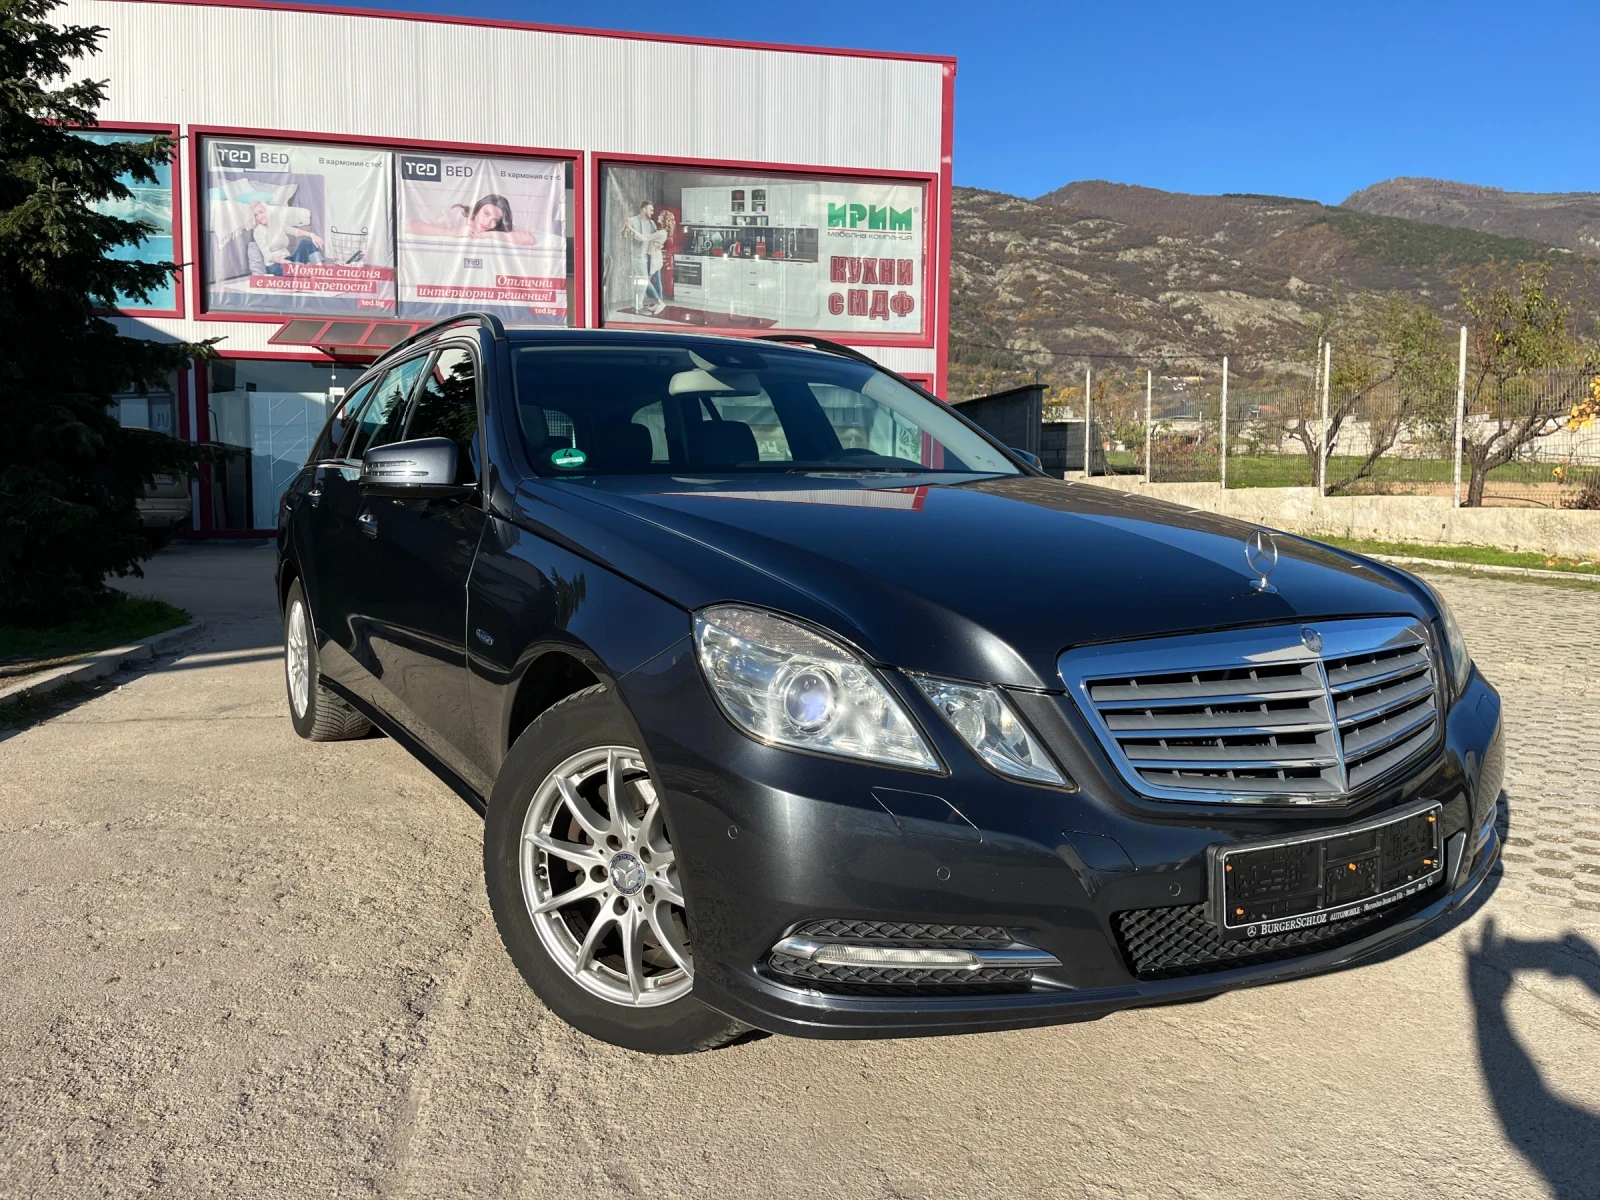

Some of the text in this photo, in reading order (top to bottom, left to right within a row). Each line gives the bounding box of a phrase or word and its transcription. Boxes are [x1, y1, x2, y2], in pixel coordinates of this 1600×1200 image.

[260, 153, 289, 166] BED
[326, 159, 364, 167] хармония
[445, 165, 473, 178] BED
[507, 172, 543, 180] хармония
[828, 203, 912, 231] ИРИМ
[287, 264, 381, 279] Моята спалня
[831, 256, 913, 285] КУХНИ
[256, 279, 373, 292] е моята крепост!
[497, 276, 553, 288] Отлични
[419, 287, 553, 301] интериорни решения!
[361, 299, 386, 308] ted.bg
[535, 307, 557, 316] ted.bg
